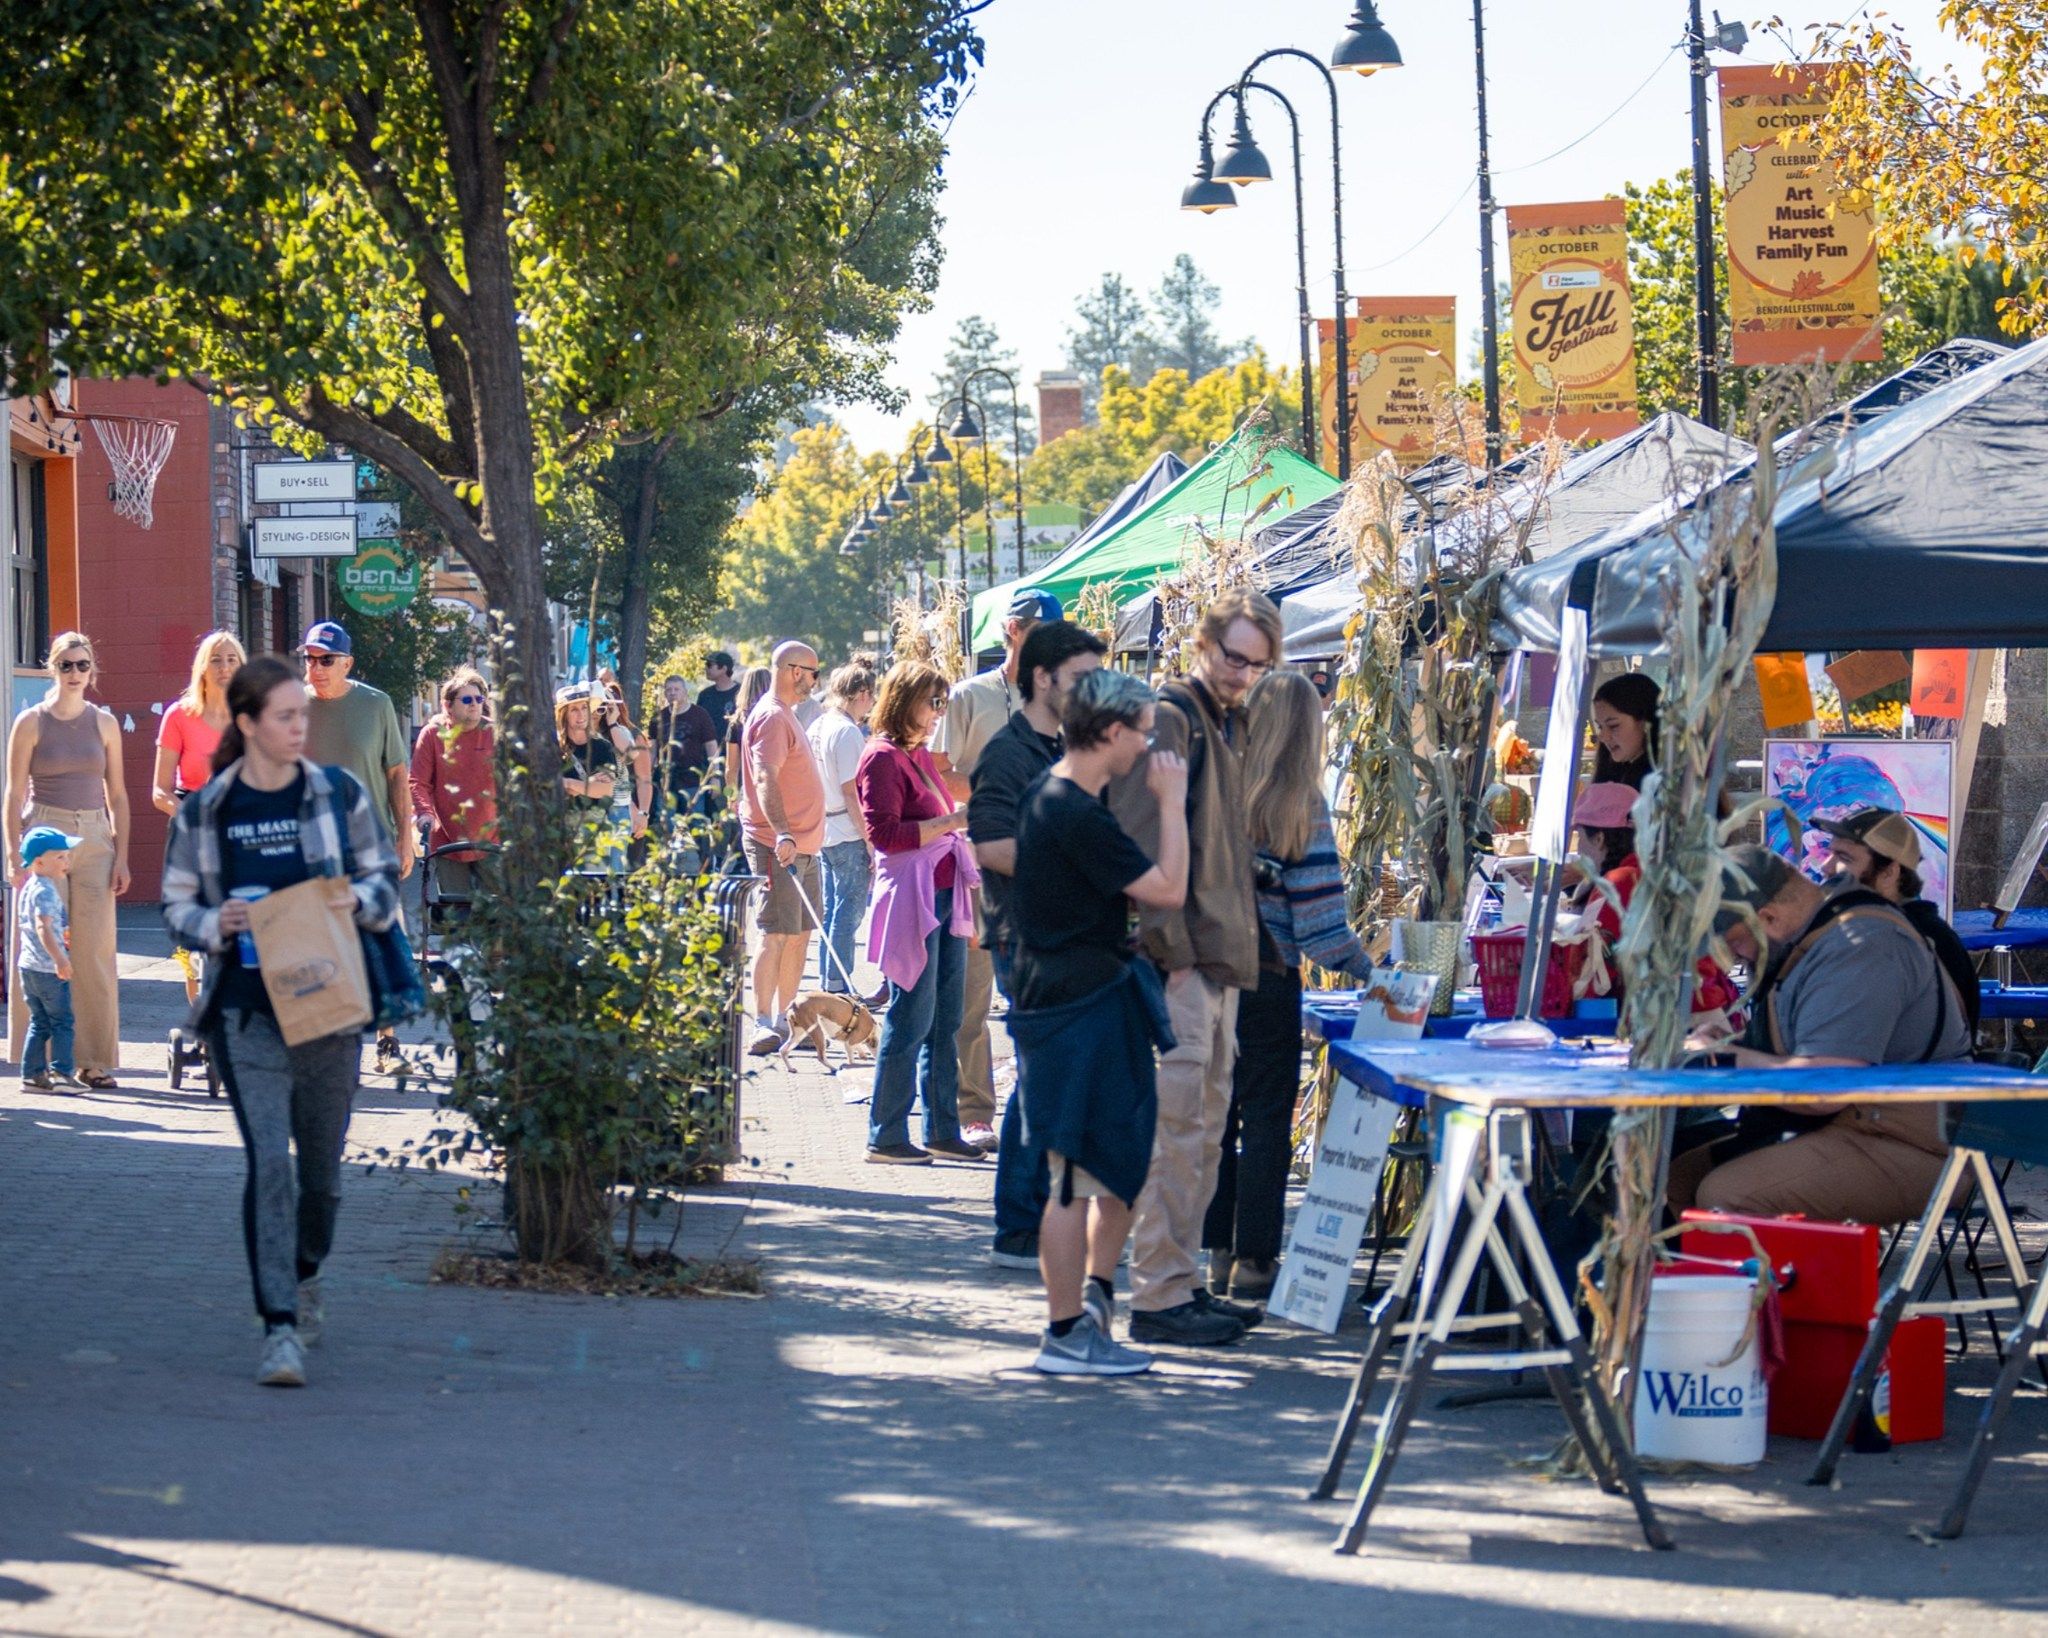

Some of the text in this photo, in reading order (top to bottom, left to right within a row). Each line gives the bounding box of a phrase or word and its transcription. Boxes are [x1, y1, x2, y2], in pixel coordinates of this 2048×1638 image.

[1757, 113, 1829, 128] OCTOBE
[1771, 155, 1823, 166] CELEBRAT
[1786, 186, 1813, 201] Art
[1776, 205, 1825, 221] Music
[1768, 225, 1835, 240] Harvest
[1539, 242, 1599, 254] OCTOBER
[1757, 243, 1848, 262] Family Fun
[1756, 303, 1856, 315] BENDFALLFESTIVAL.COM
[1526, 290, 1616, 352] Fall
[1381, 329, 1432, 338] OCTOBER
[1548, 320, 1618, 363] Festival
[1398, 377, 1416, 386] Art
[1540, 392, 1620, 403] BENALLFESTIVAL.COM
[257, 819, 298, 836] MAST
[1643, 1369, 1744, 1416] Wilco
